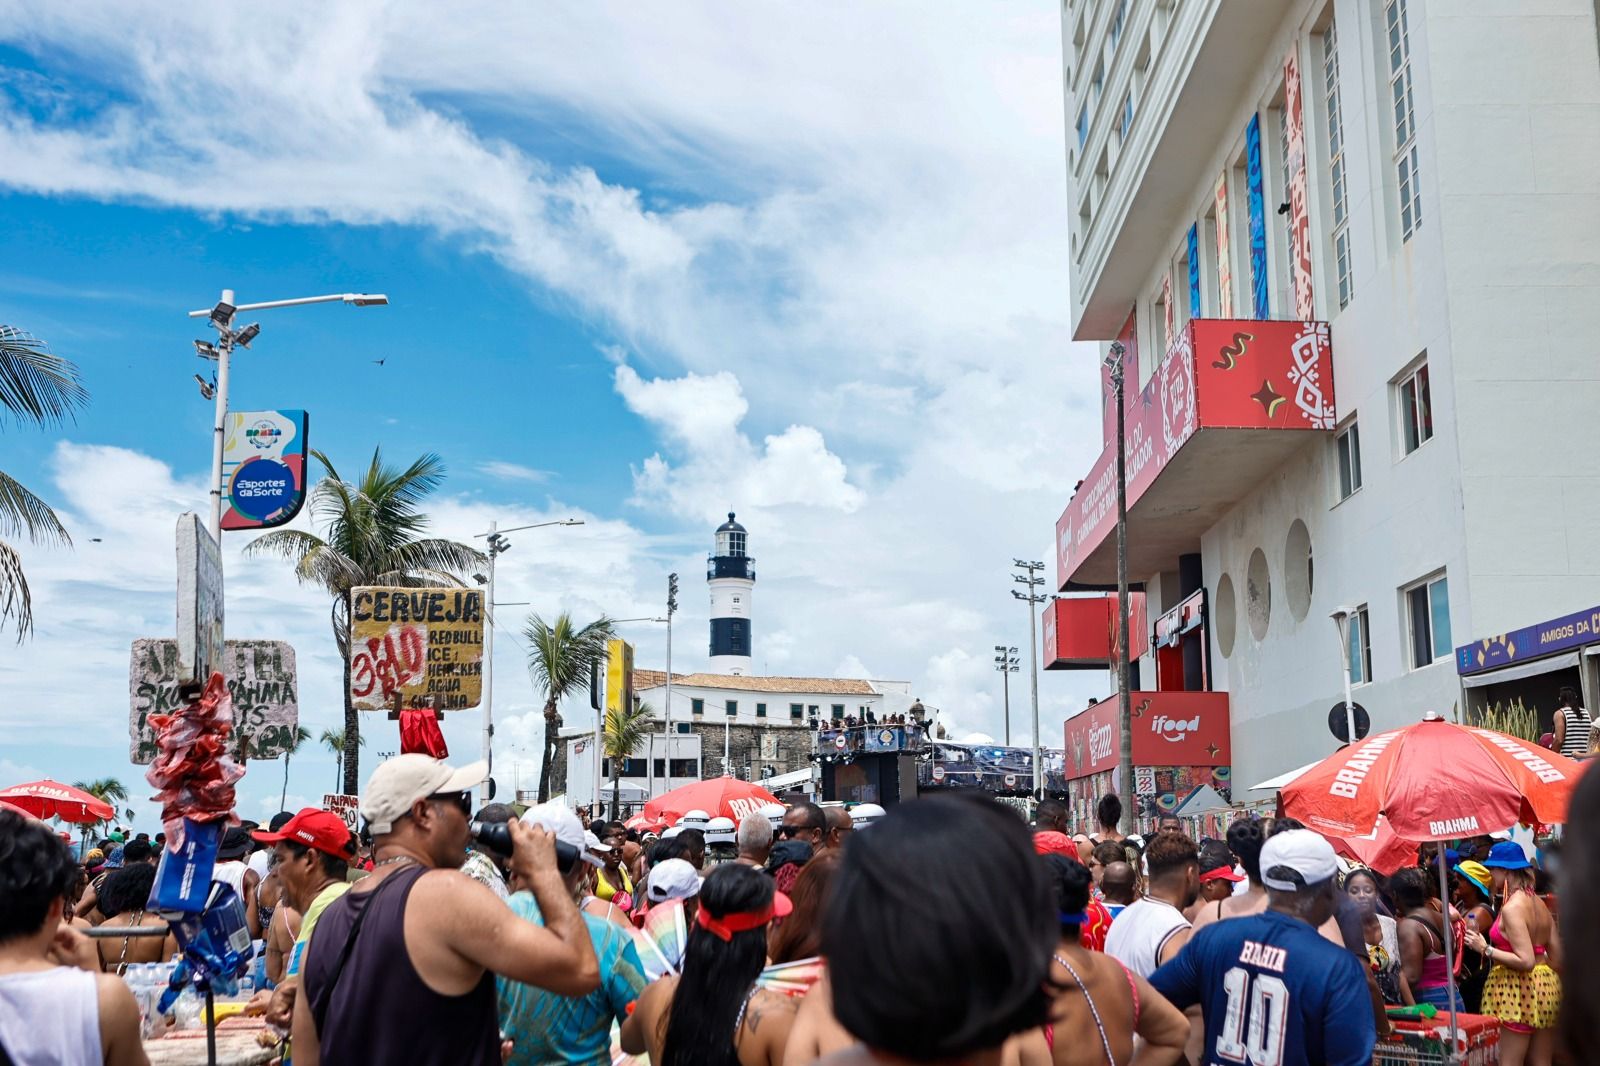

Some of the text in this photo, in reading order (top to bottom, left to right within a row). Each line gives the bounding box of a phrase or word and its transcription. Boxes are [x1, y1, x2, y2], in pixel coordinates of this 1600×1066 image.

[1133, 422, 1143, 449] DO
[237, 479, 286, 489] Esportes
[354, 591, 481, 623] CERVEJA
[1540, 624, 1574, 644] AMIGOS
[1576, 620, 1590, 634] DA
[427, 648, 451, 662] ICE
[352, 652, 376, 698] 3
[1429, 816, 1479, 836] BRAHMA
[1239, 940, 1287, 972] BAHIA
[1216, 966, 1289, 1066] 10
